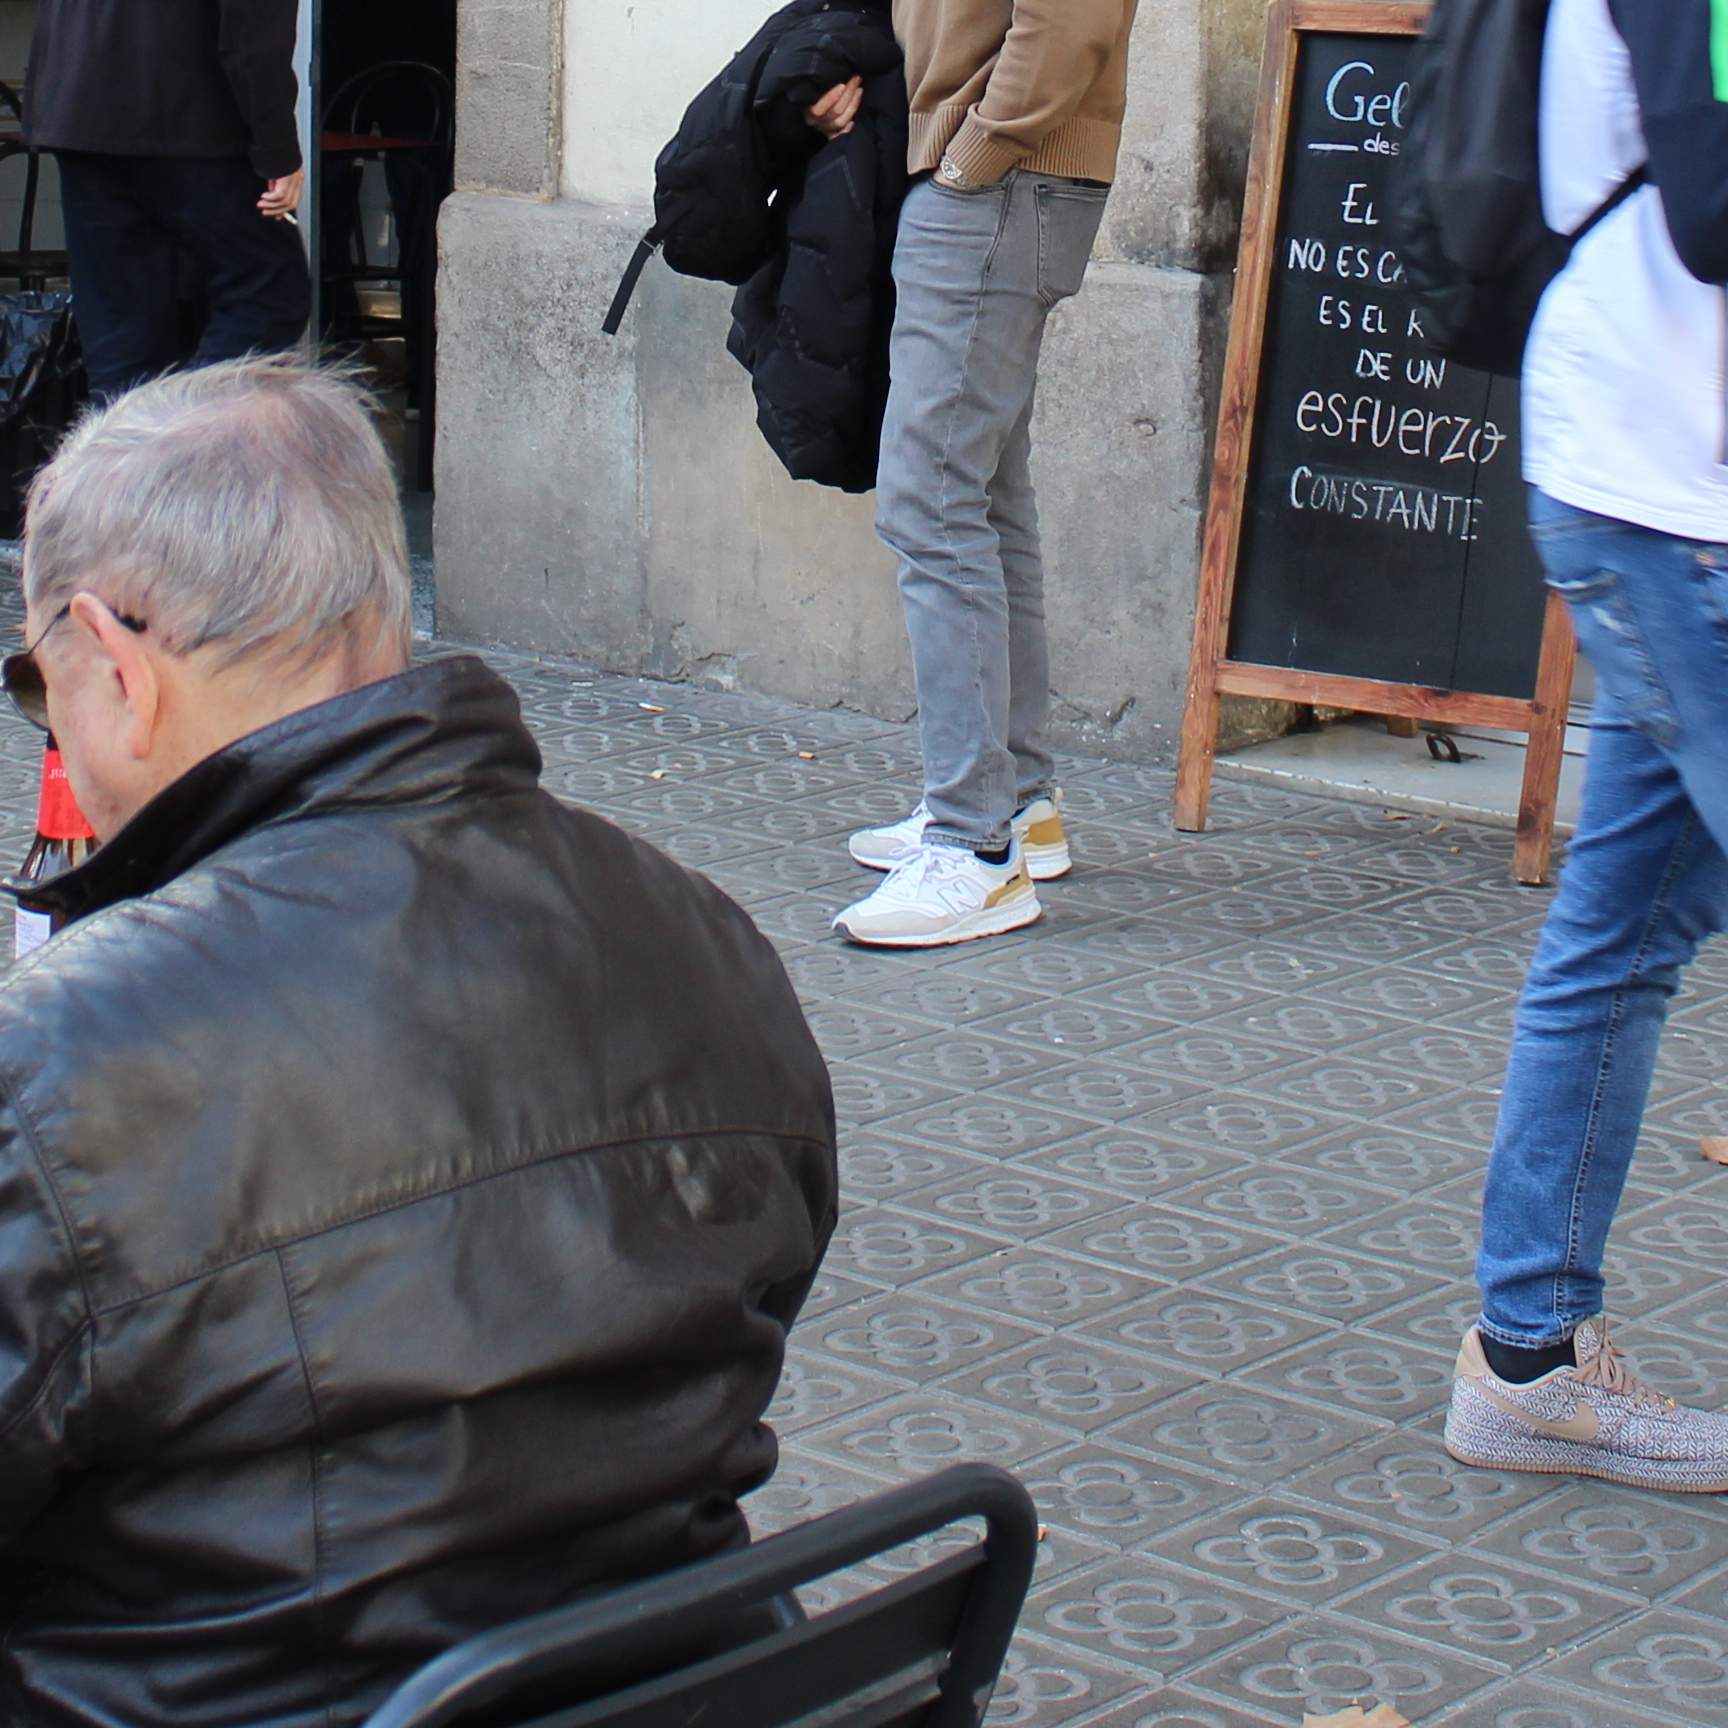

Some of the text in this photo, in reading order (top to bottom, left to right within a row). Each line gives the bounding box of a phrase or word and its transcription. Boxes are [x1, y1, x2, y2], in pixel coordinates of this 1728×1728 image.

[1325, 60, 1410, 129] Gel
[1363, 132, 1400, 156] des
[1287, 238, 1327, 273] NO
[1336, 244, 1370, 278] ES
[1319, 294, 1351, 329] ES
[1355, 348, 1447, 391] DE UN
[1296, 390, 1508, 464] esfuerzo
[1290, 465, 1484, 541] CONSTANTE
